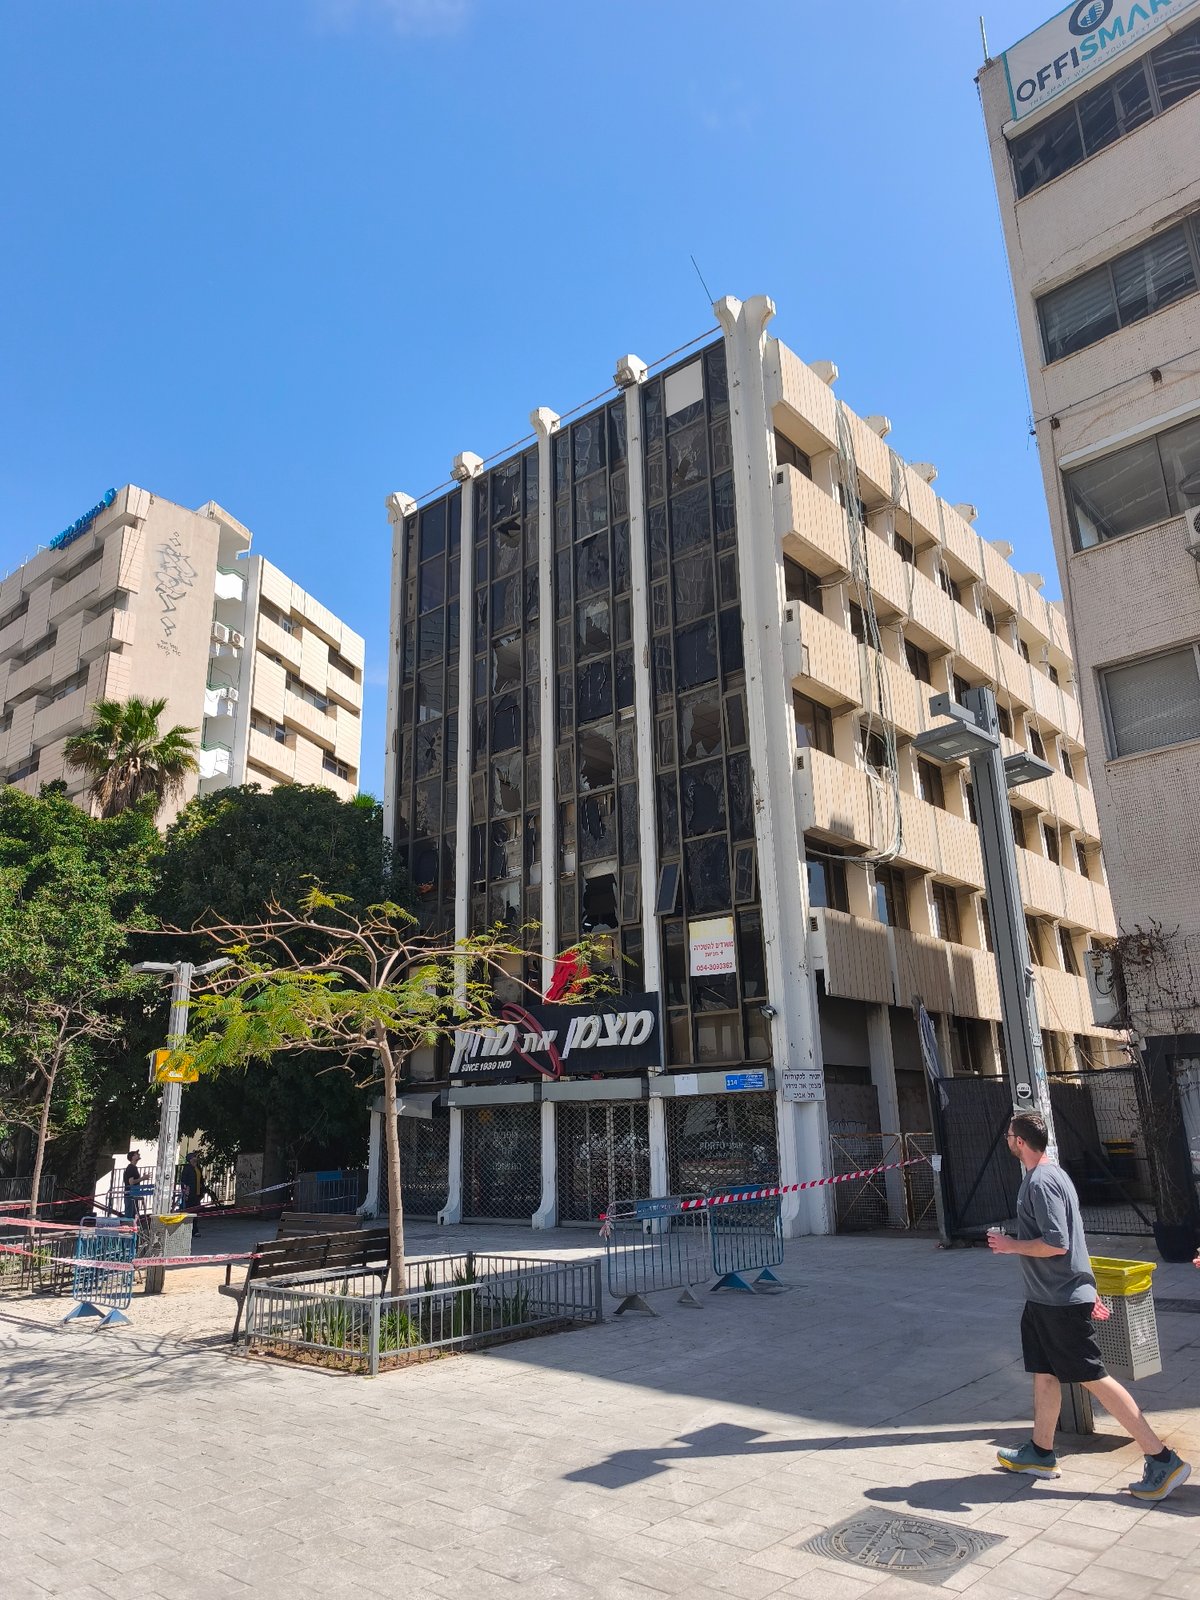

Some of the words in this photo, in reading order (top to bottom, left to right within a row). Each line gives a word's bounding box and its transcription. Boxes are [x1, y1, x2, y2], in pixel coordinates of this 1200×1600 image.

[1030, 95, 1045, 106] THE
[1046, 77, 1071, 96] SMART
[1074, 65, 1090, 78] WAY
[1105, 39, 1127, 55] YOUR
[1130, 23, 1151, 41] NEXT
[520, 1030, 559, 1053] את
[558, 1009, 655, 1061] מצמן
[461, 1063, 480, 1072] SINCE
[480, 1061, 497, 1071] 1939
